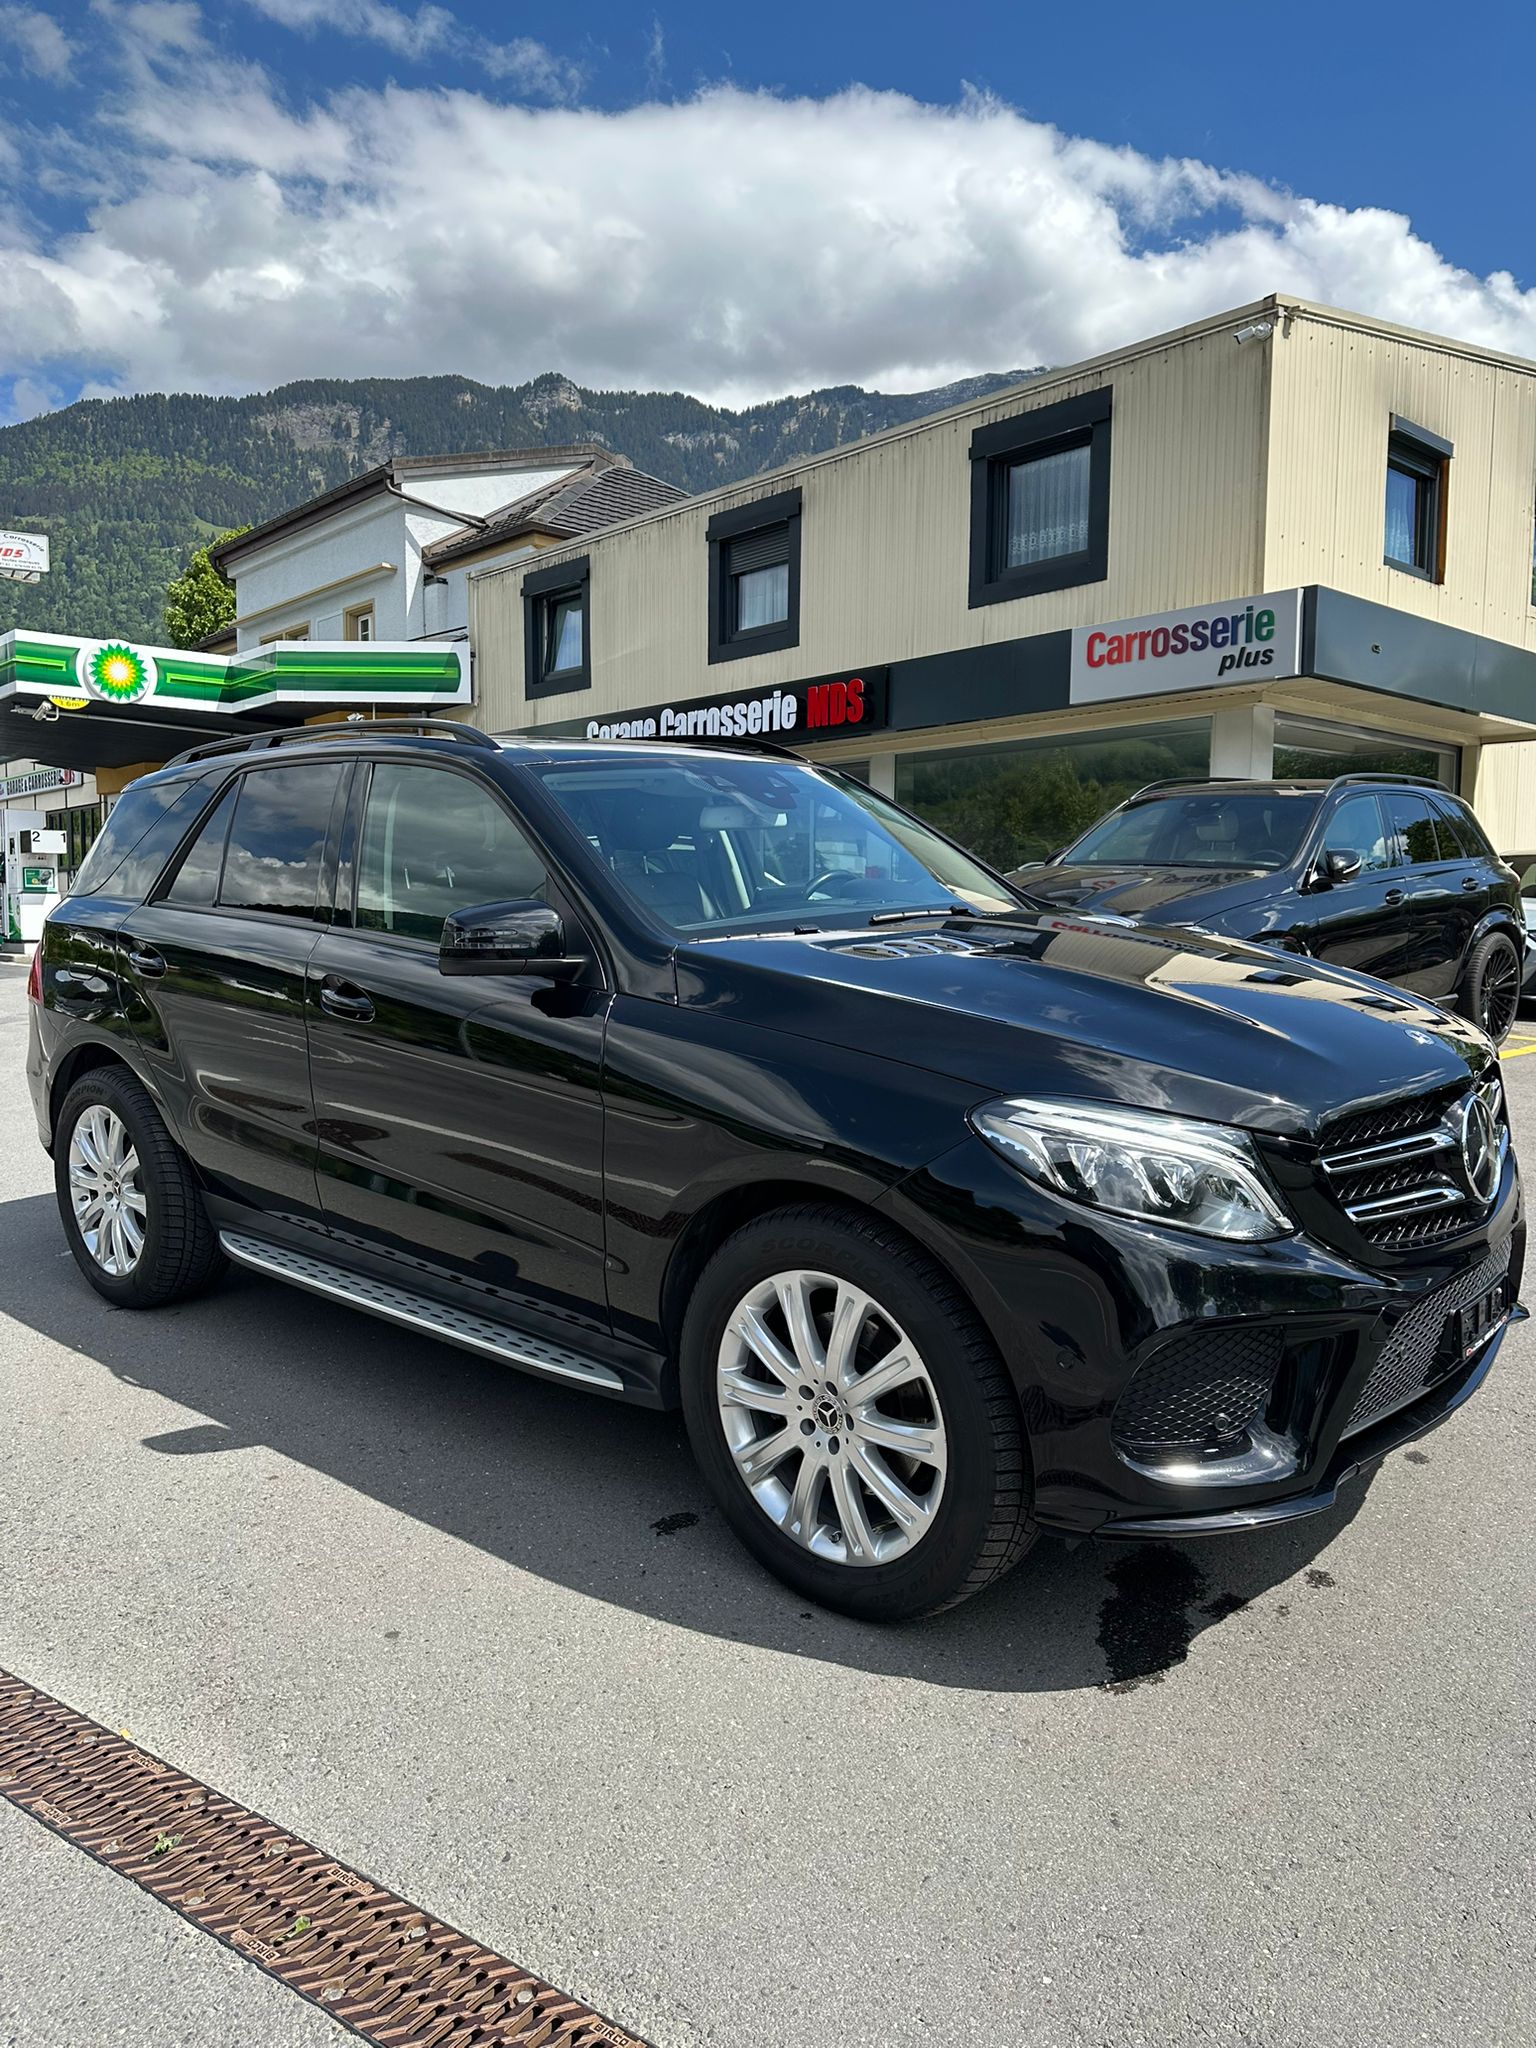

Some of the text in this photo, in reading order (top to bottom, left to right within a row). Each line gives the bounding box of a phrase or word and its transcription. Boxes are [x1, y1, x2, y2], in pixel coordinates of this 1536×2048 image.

[1087, 605, 1275, 669] Carrosserie
[1217, 646, 1275, 677] plus
[660, 690, 797, 737] Carrosserie
[807, 678, 864, 728] MDS
[32, 831, 66, 843] 2 1
[331, 1869, 360, 1887] BIRCO
[246, 1940, 276, 1960] BIRCO
[594, 2023, 630, 2046] BIRCO
